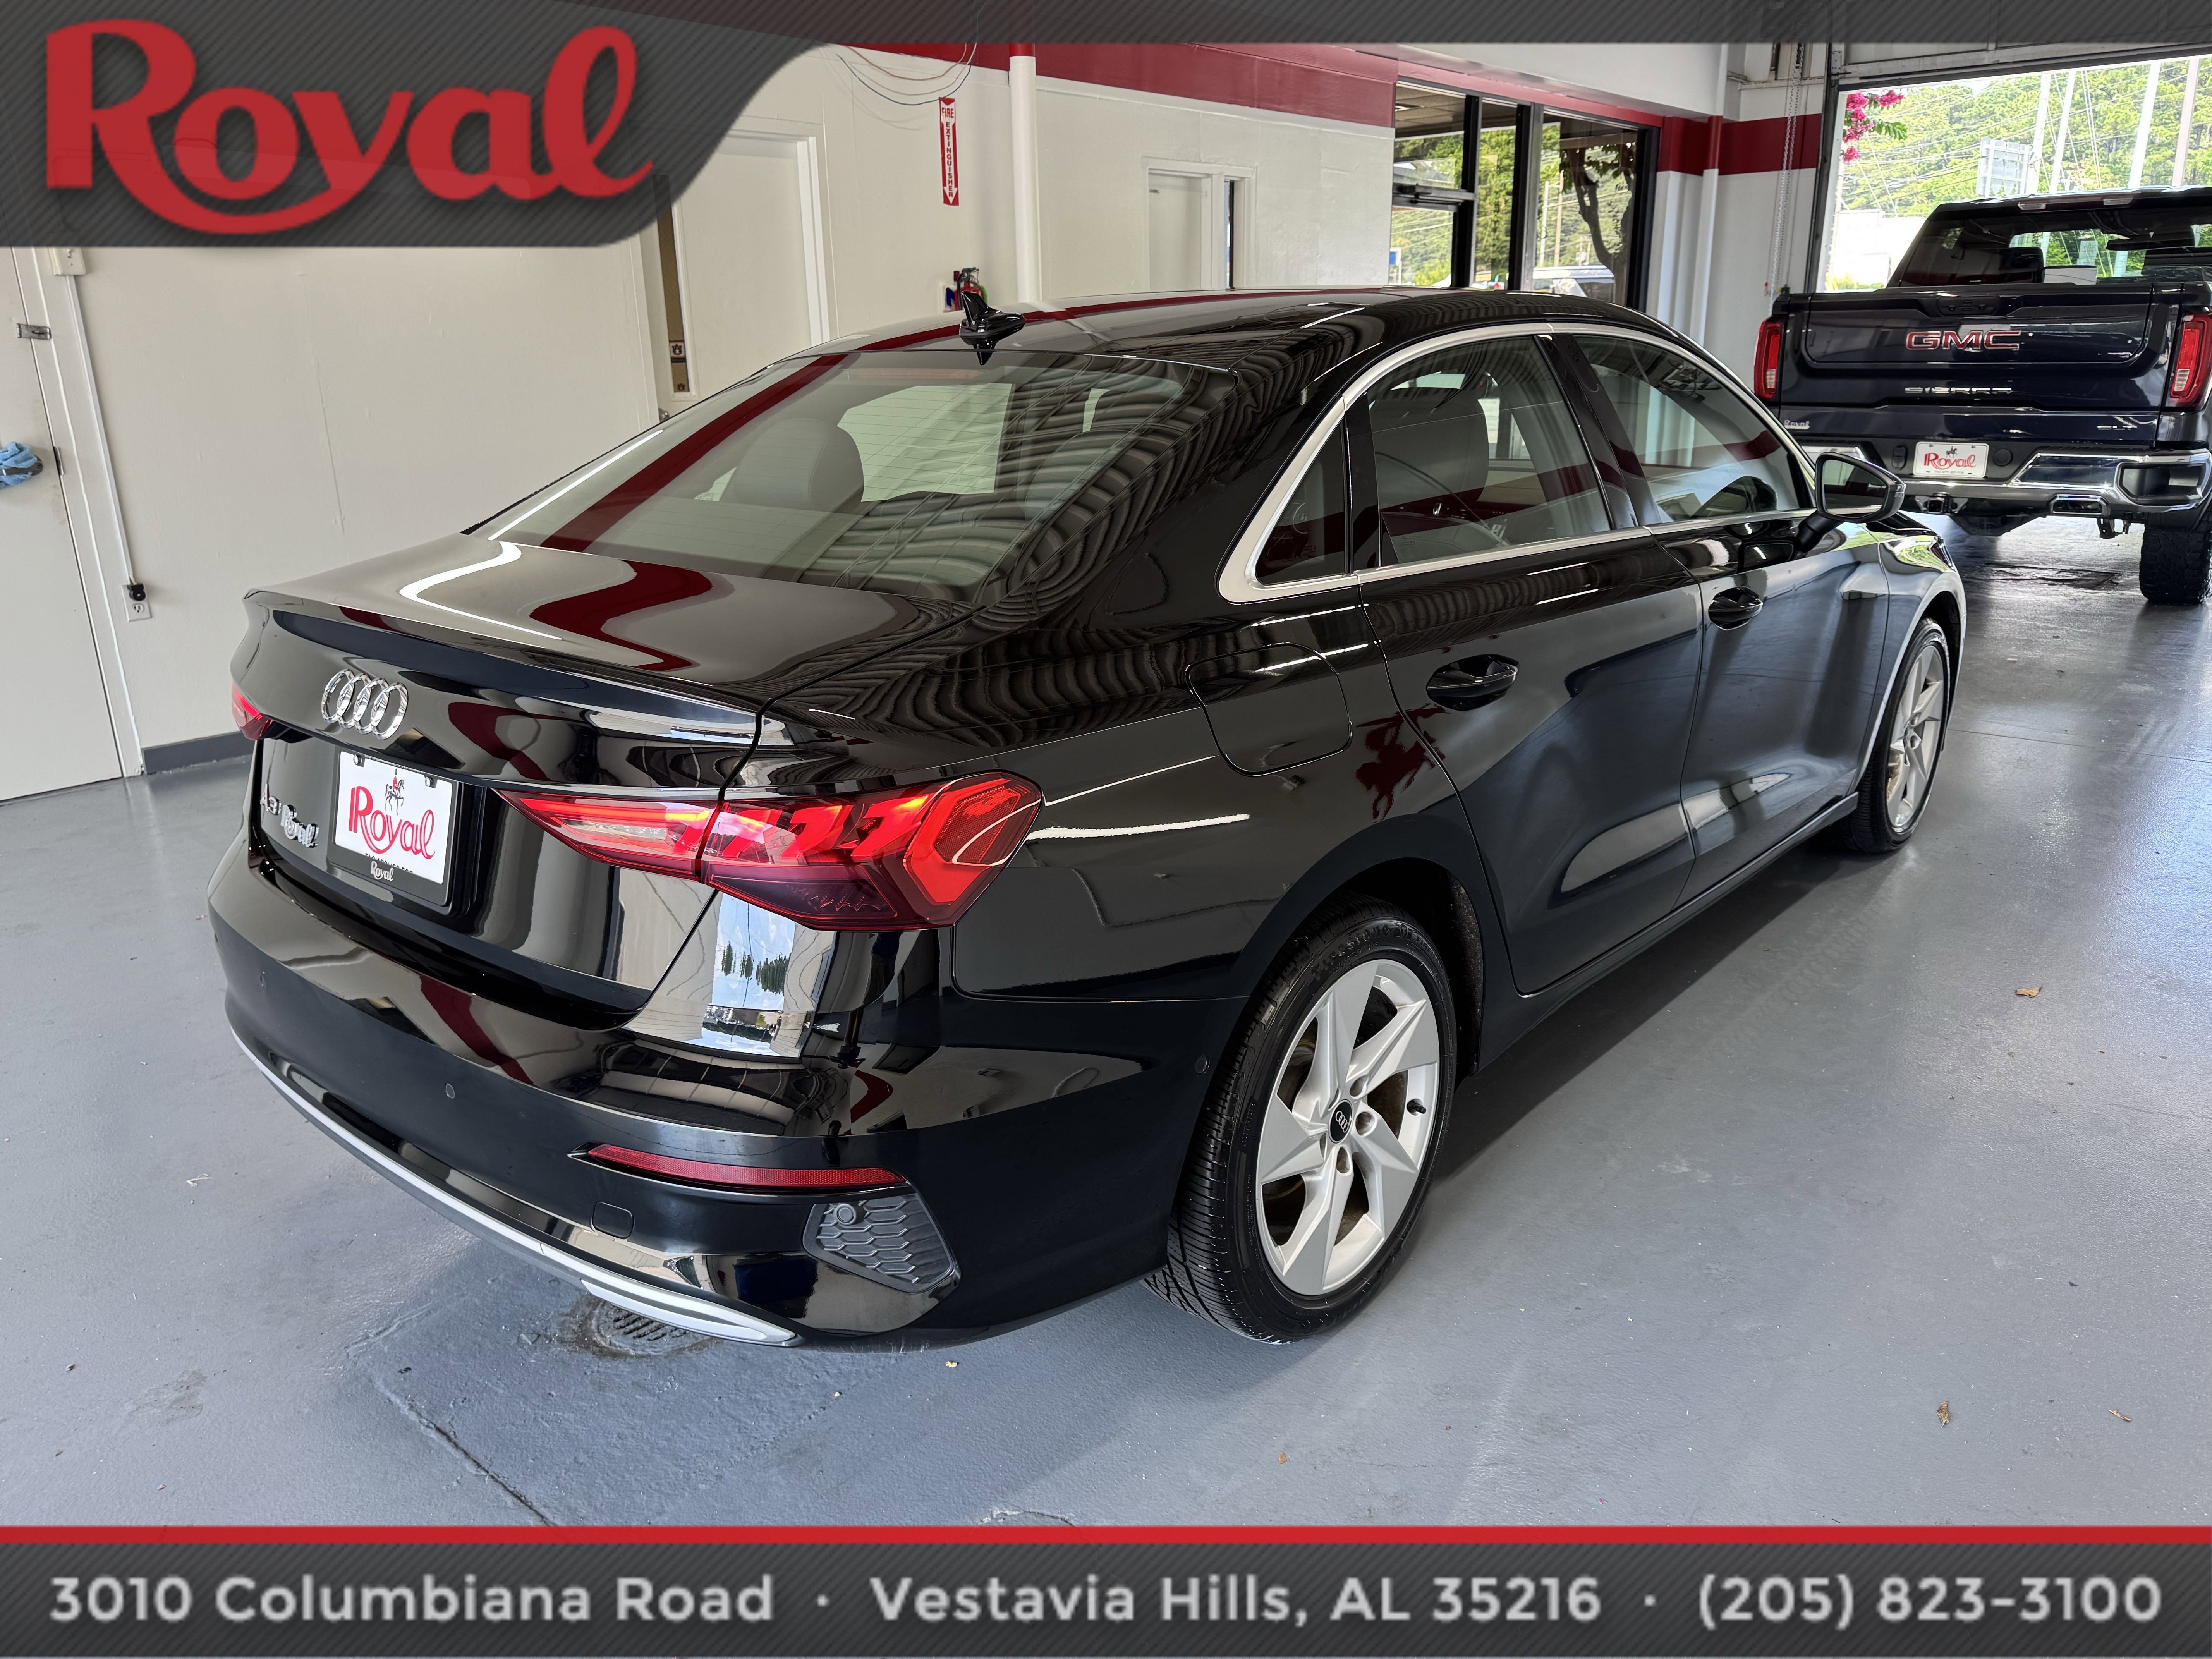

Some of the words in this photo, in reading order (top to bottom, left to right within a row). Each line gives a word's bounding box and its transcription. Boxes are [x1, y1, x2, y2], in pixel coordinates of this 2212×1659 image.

[942, 107, 954, 118] FIRE
[1906, 330, 2021, 350] GMC
[1784, 419, 1810, 430] Royal
[1923, 452, 1977, 470] Royal
[280, 804, 319, 848] Royal
[348, 786, 436, 860] Royal
[370, 861, 394, 881] Royal
